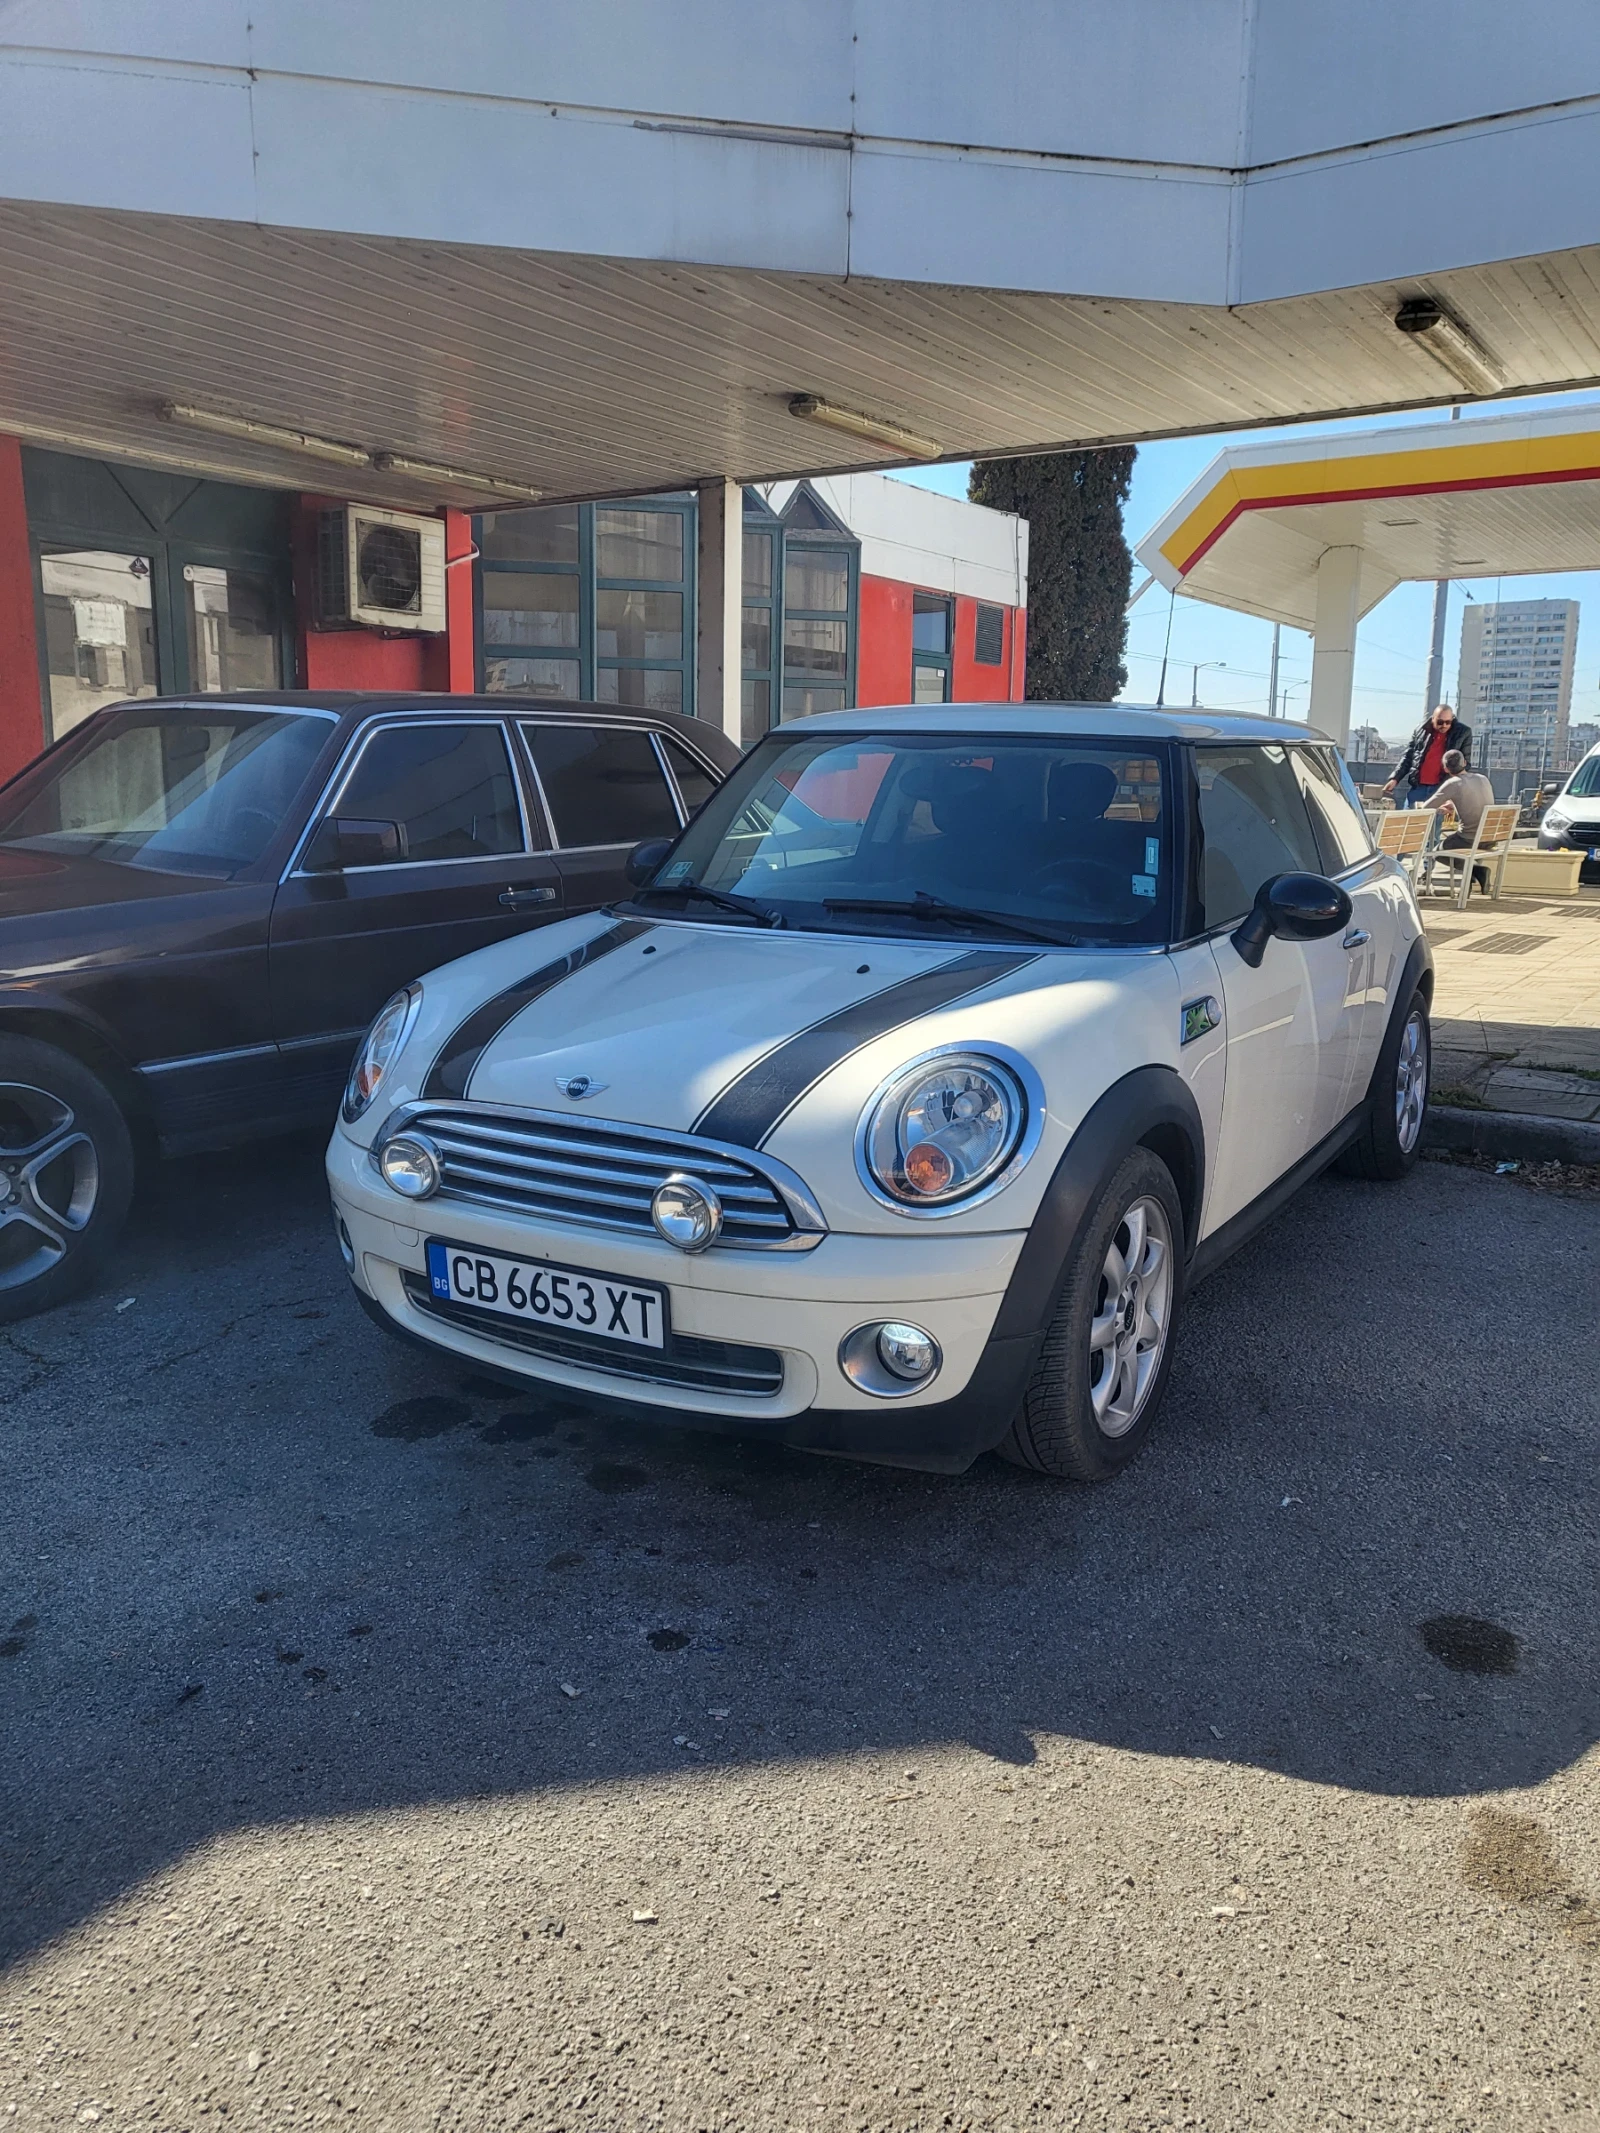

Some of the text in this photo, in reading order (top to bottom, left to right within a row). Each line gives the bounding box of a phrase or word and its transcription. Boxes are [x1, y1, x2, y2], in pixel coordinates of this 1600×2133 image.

[568, 1082, 588, 1091] MINI
[433, 1276, 448, 1291] BG
[452, 1255, 656, 1339] CB 6653 XT
